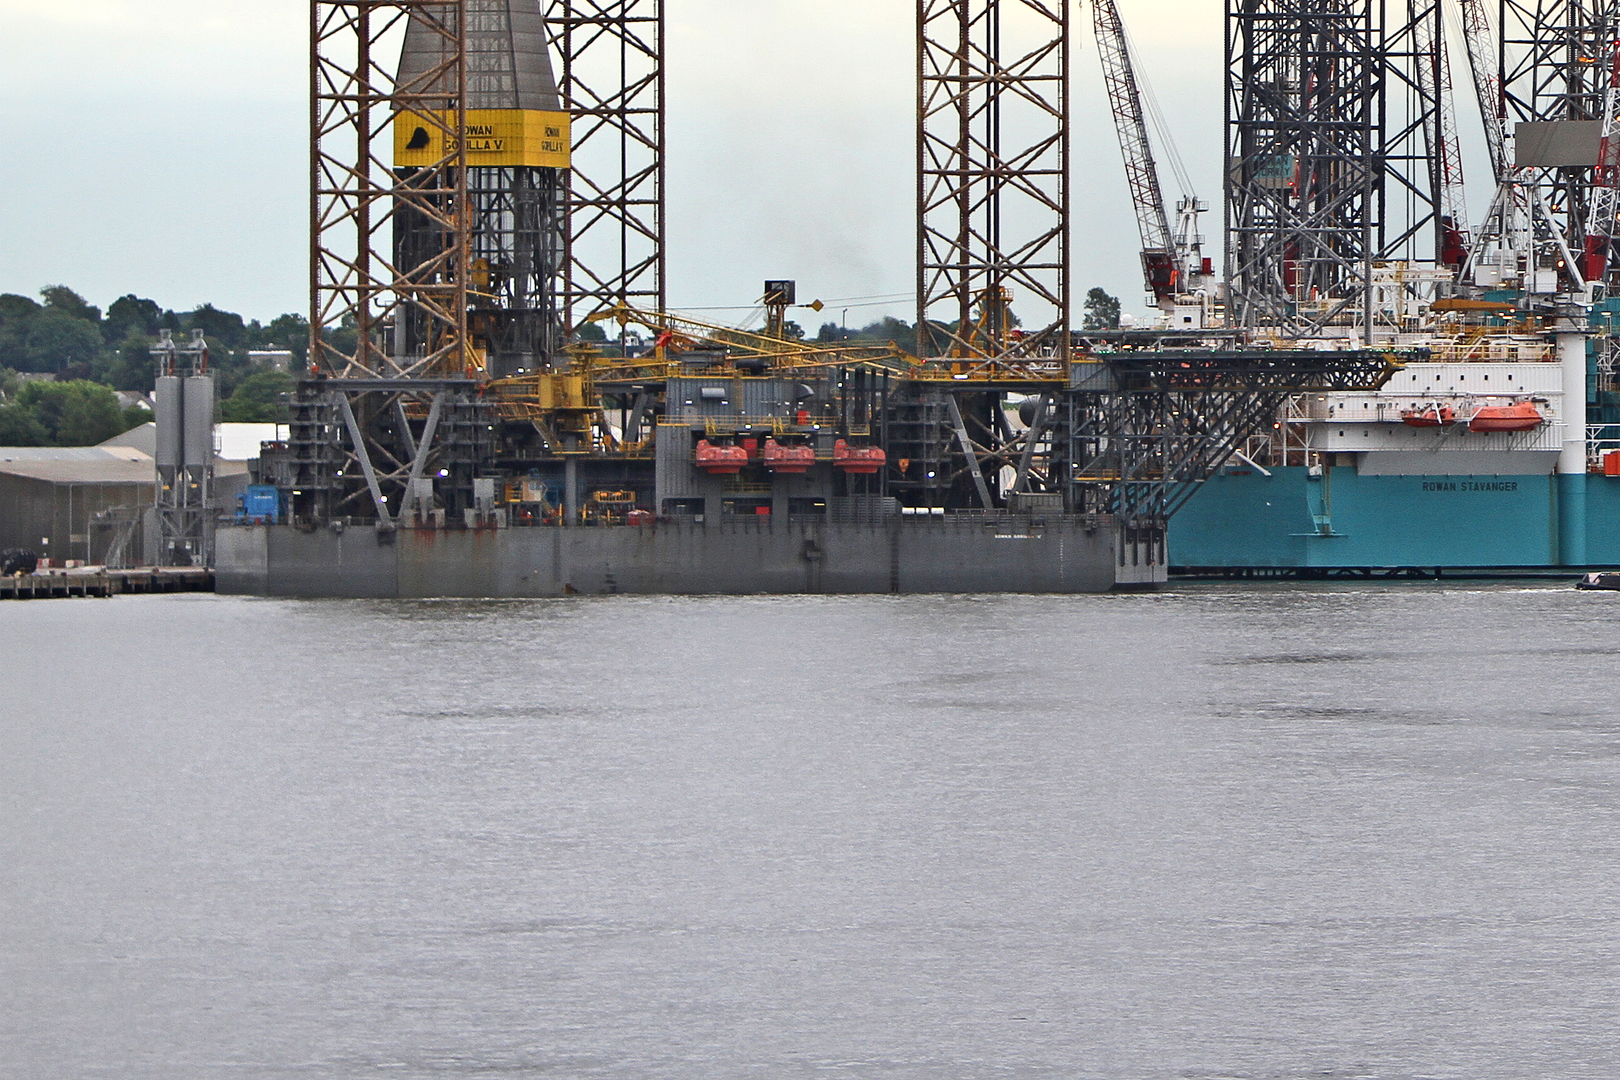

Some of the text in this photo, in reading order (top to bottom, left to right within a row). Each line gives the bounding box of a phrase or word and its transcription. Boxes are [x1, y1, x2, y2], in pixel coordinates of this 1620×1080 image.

[445, 140, 503, 149] GOILLA V
[1422, 482, 1518, 491] ROWAN STAVANGER
